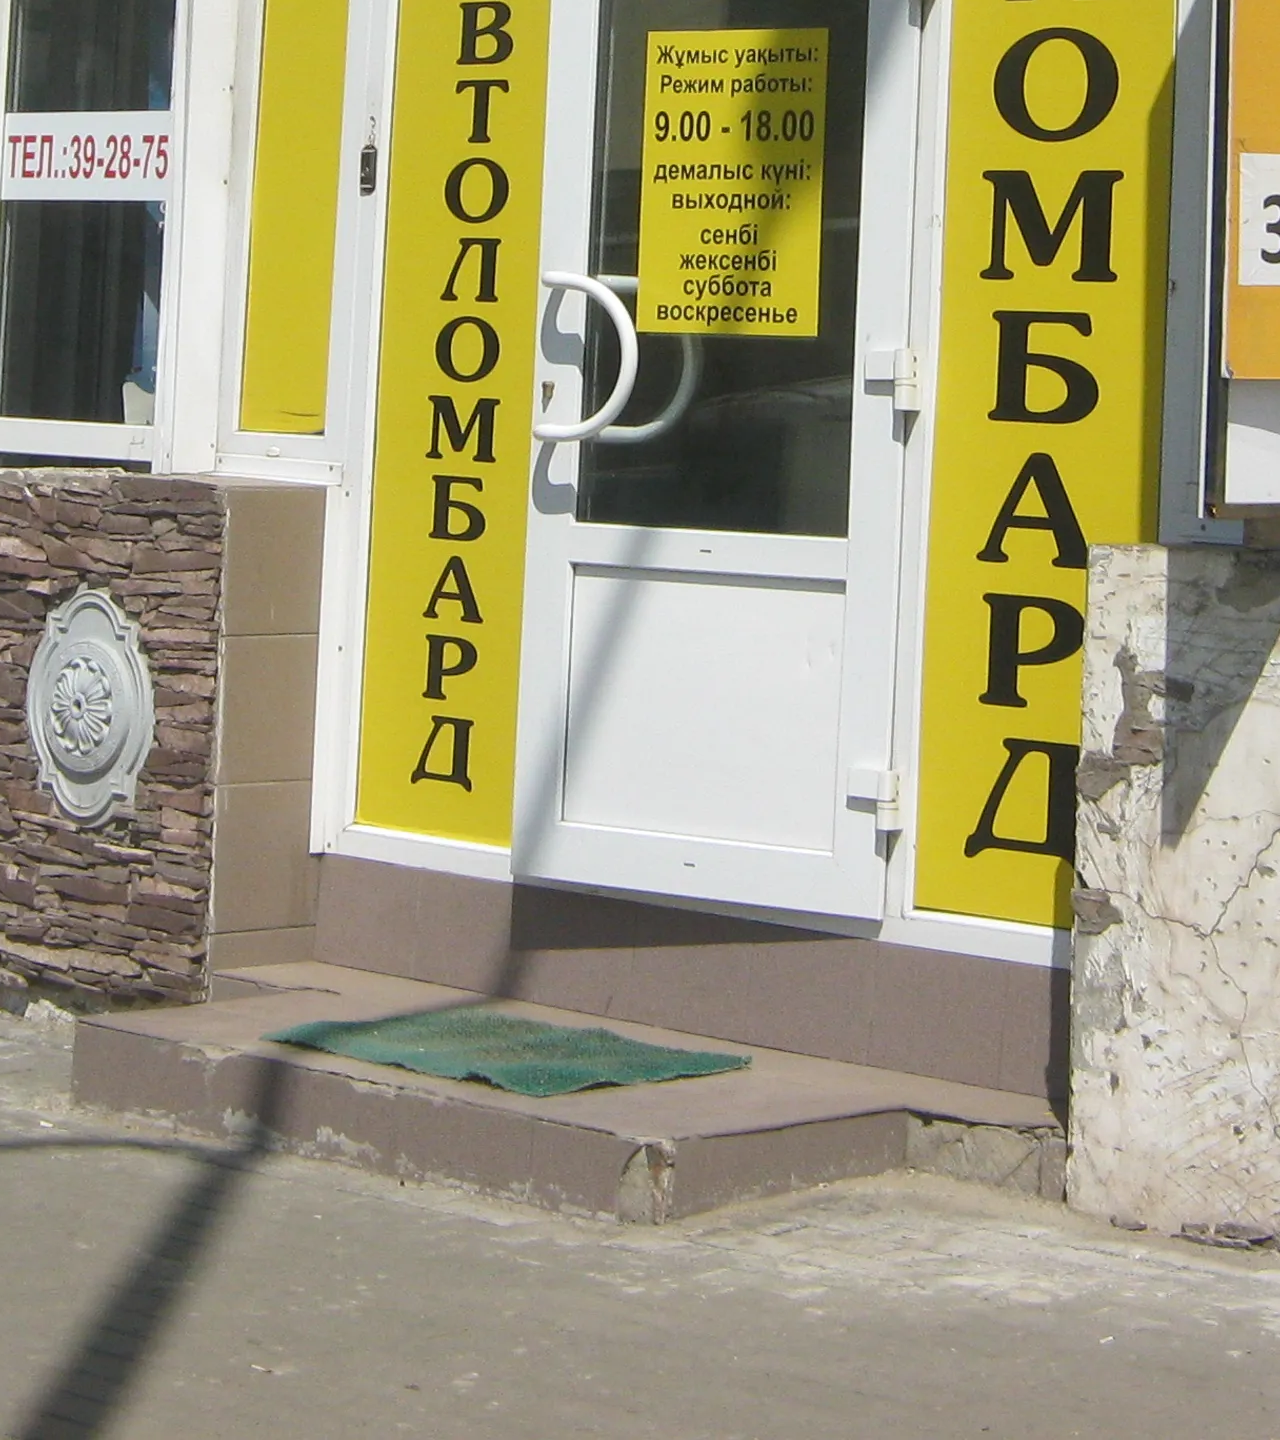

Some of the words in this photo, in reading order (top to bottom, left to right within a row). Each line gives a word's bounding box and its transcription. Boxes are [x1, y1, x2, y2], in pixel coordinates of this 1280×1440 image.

[657, 45, 729, 69] Жұмыс
[660, 74, 724, 94] Режим
[730, 73, 813, 98] работы:
[654, 110, 711, 142] 9.00
[740, 110, 814, 142] 18.00
[653, 163, 753, 183] демалыс
[761, 159, 812, 185] күні:
[672, 188, 791, 212] выходной:
[700, 223, 758, 245] сенбі
[679, 250, 777, 271] жексенбі
[683, 274, 772, 300] суббота
[656, 304, 798, 327] воскресенье
